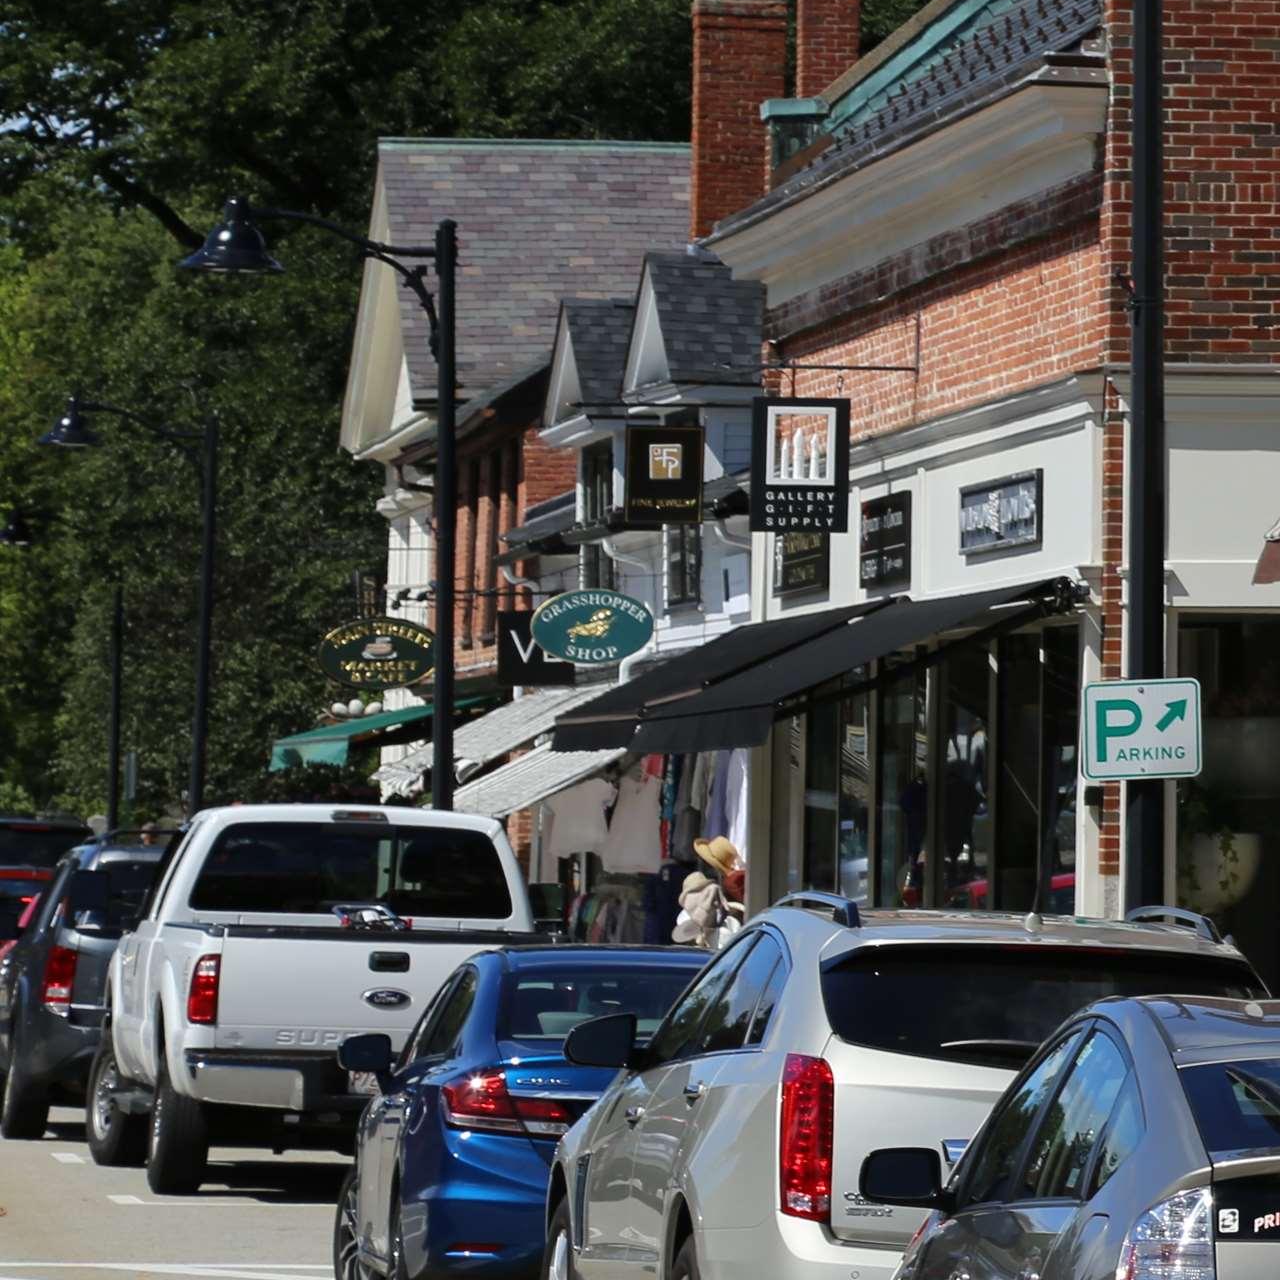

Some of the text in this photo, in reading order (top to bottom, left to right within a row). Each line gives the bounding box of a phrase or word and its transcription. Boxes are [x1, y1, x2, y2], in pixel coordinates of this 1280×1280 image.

[765, 491, 835, 501] GALLERY
[765, 517, 834, 527] SUPPLY
[540, 593, 648, 624] GRASSHOPPER
[565, 644, 619, 661] SHOP
[340, 660, 417, 671] MARKET
